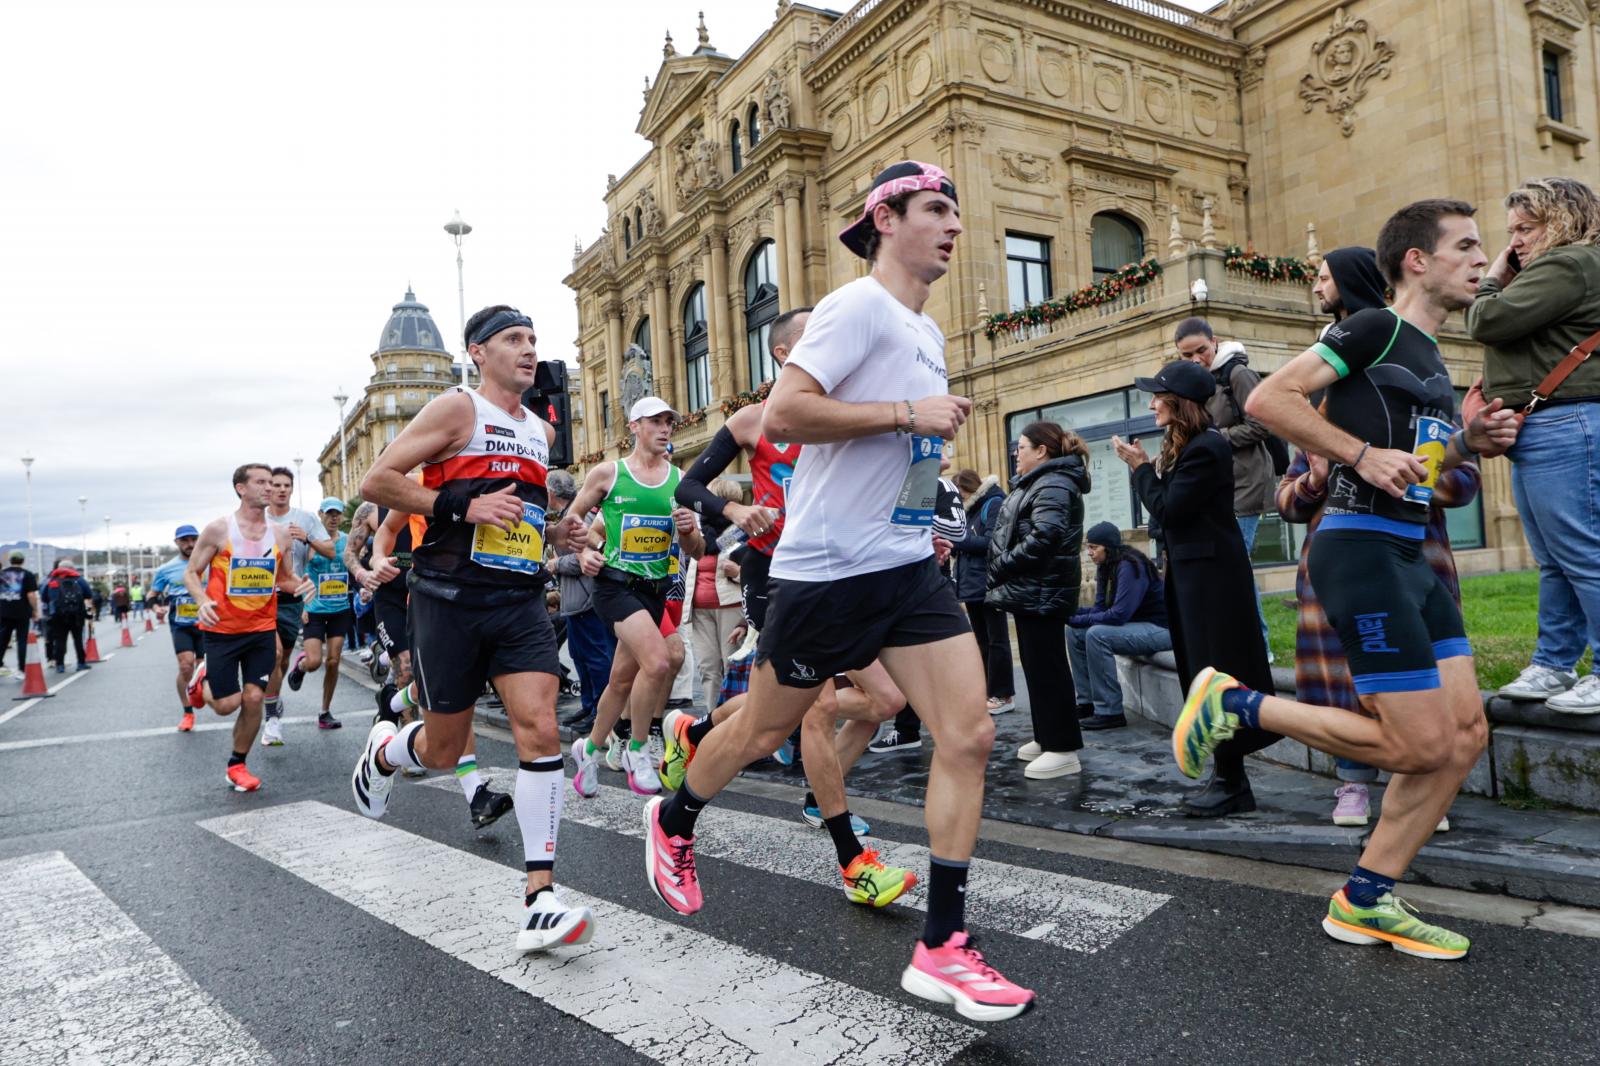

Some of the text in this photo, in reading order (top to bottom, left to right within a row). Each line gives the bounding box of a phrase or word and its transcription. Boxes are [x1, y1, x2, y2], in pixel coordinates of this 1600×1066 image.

[485, 440, 536, 458] DUNBOA
[490, 461, 520, 472] RUN
[504, 531, 531, 545] JAVI
[633, 536, 667, 544] VICTOR
[506, 546, 523, 557] 569
[1353, 612, 1400, 653] land
[549, 782, 557, 840] COMPRESSPORT
